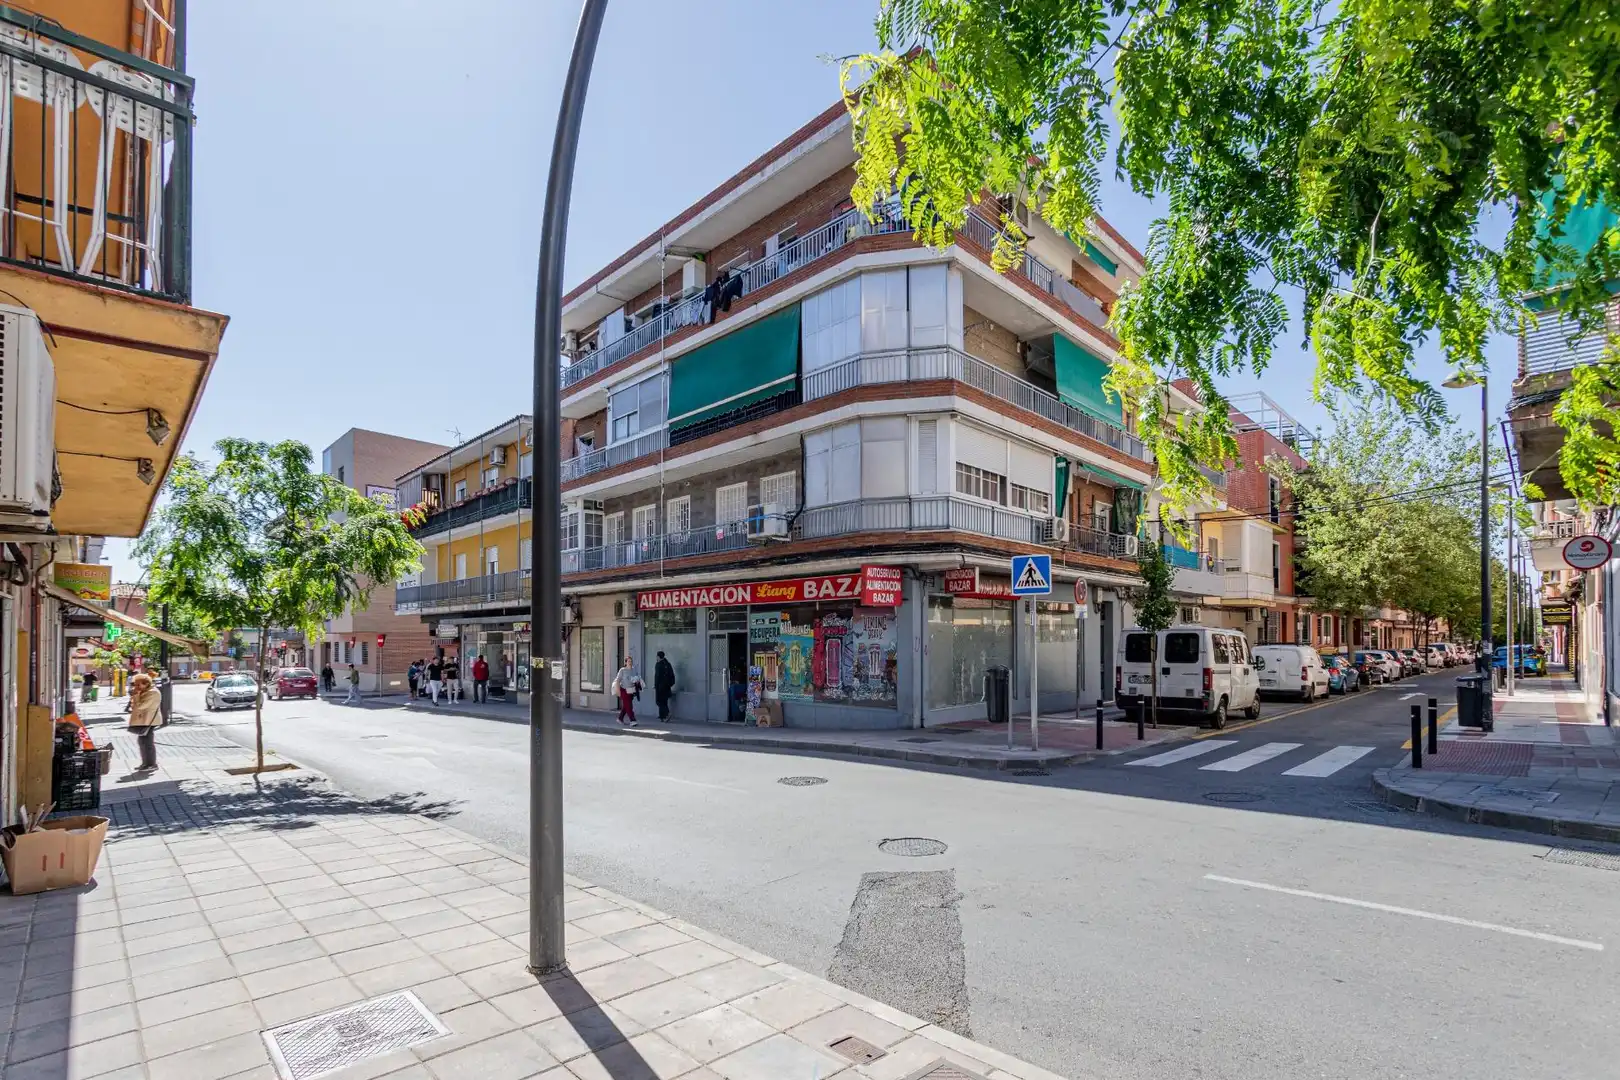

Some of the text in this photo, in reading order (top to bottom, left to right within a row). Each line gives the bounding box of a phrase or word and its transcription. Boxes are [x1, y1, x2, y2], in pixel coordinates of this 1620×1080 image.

[866, 567, 900, 579] AUTOSERVICIO
[945, 568, 975, 579] ALIMENTACION
[866, 580, 901, 591] ALIMENTACION
[949, 580, 972, 591] BAZAR
[640, 586, 751, 608] ALIMENTACION
[756, 584, 797, 600] Liang
[872, 593, 895, 603] BAZAR
[750, 627, 780, 639] RECUPERA
